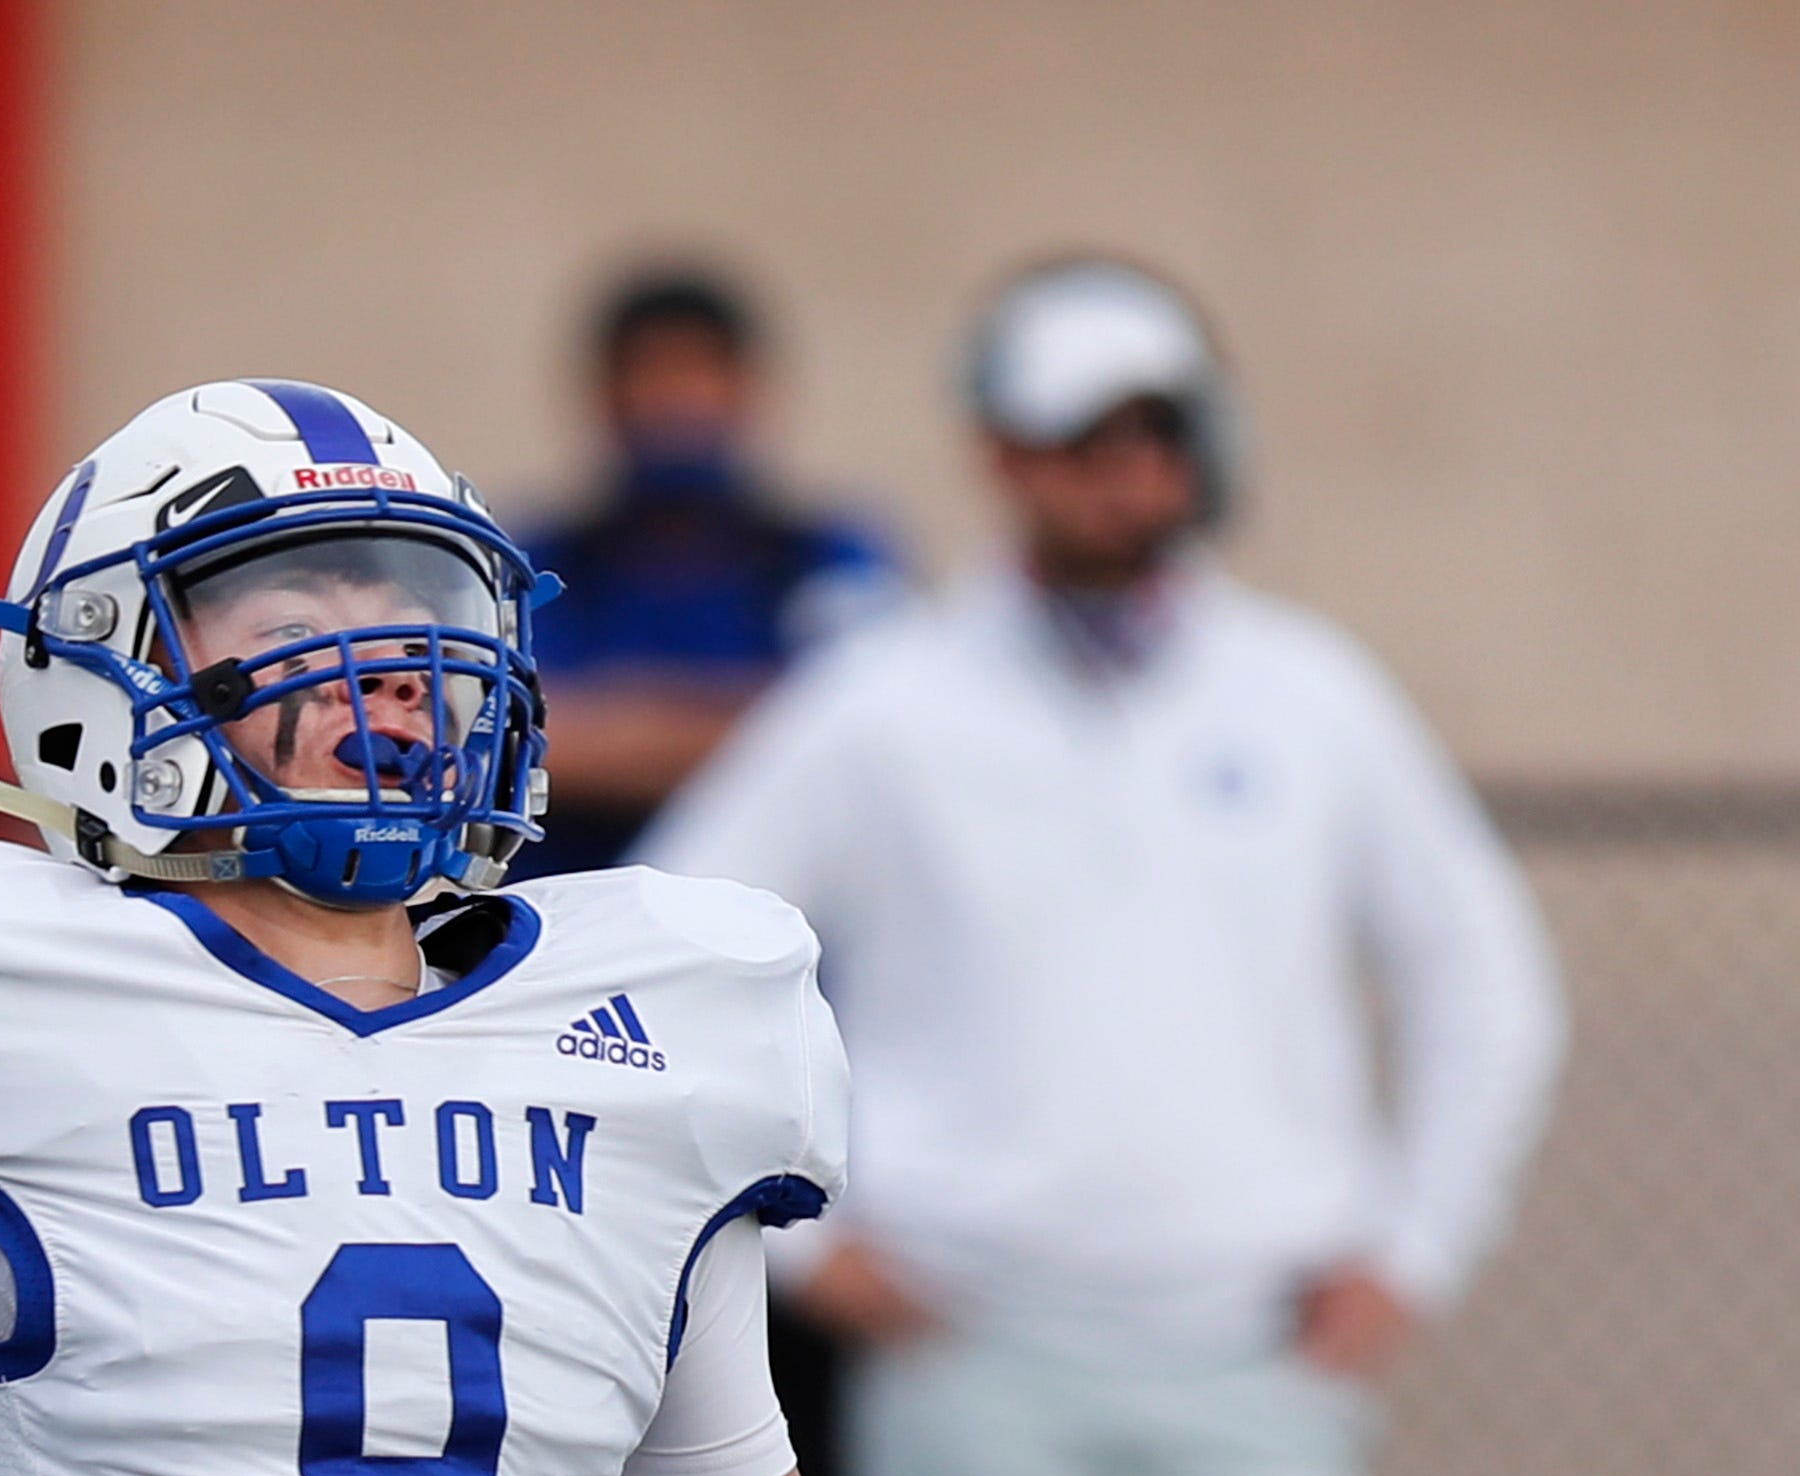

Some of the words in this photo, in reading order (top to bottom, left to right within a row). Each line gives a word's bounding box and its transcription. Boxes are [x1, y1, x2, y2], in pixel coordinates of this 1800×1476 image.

[293, 467, 417, 493] Riddell
[354, 827, 421, 843] Riddell
[556, 1032, 666, 1072] adidas
[129, 1099, 597, 1215] OLTON
